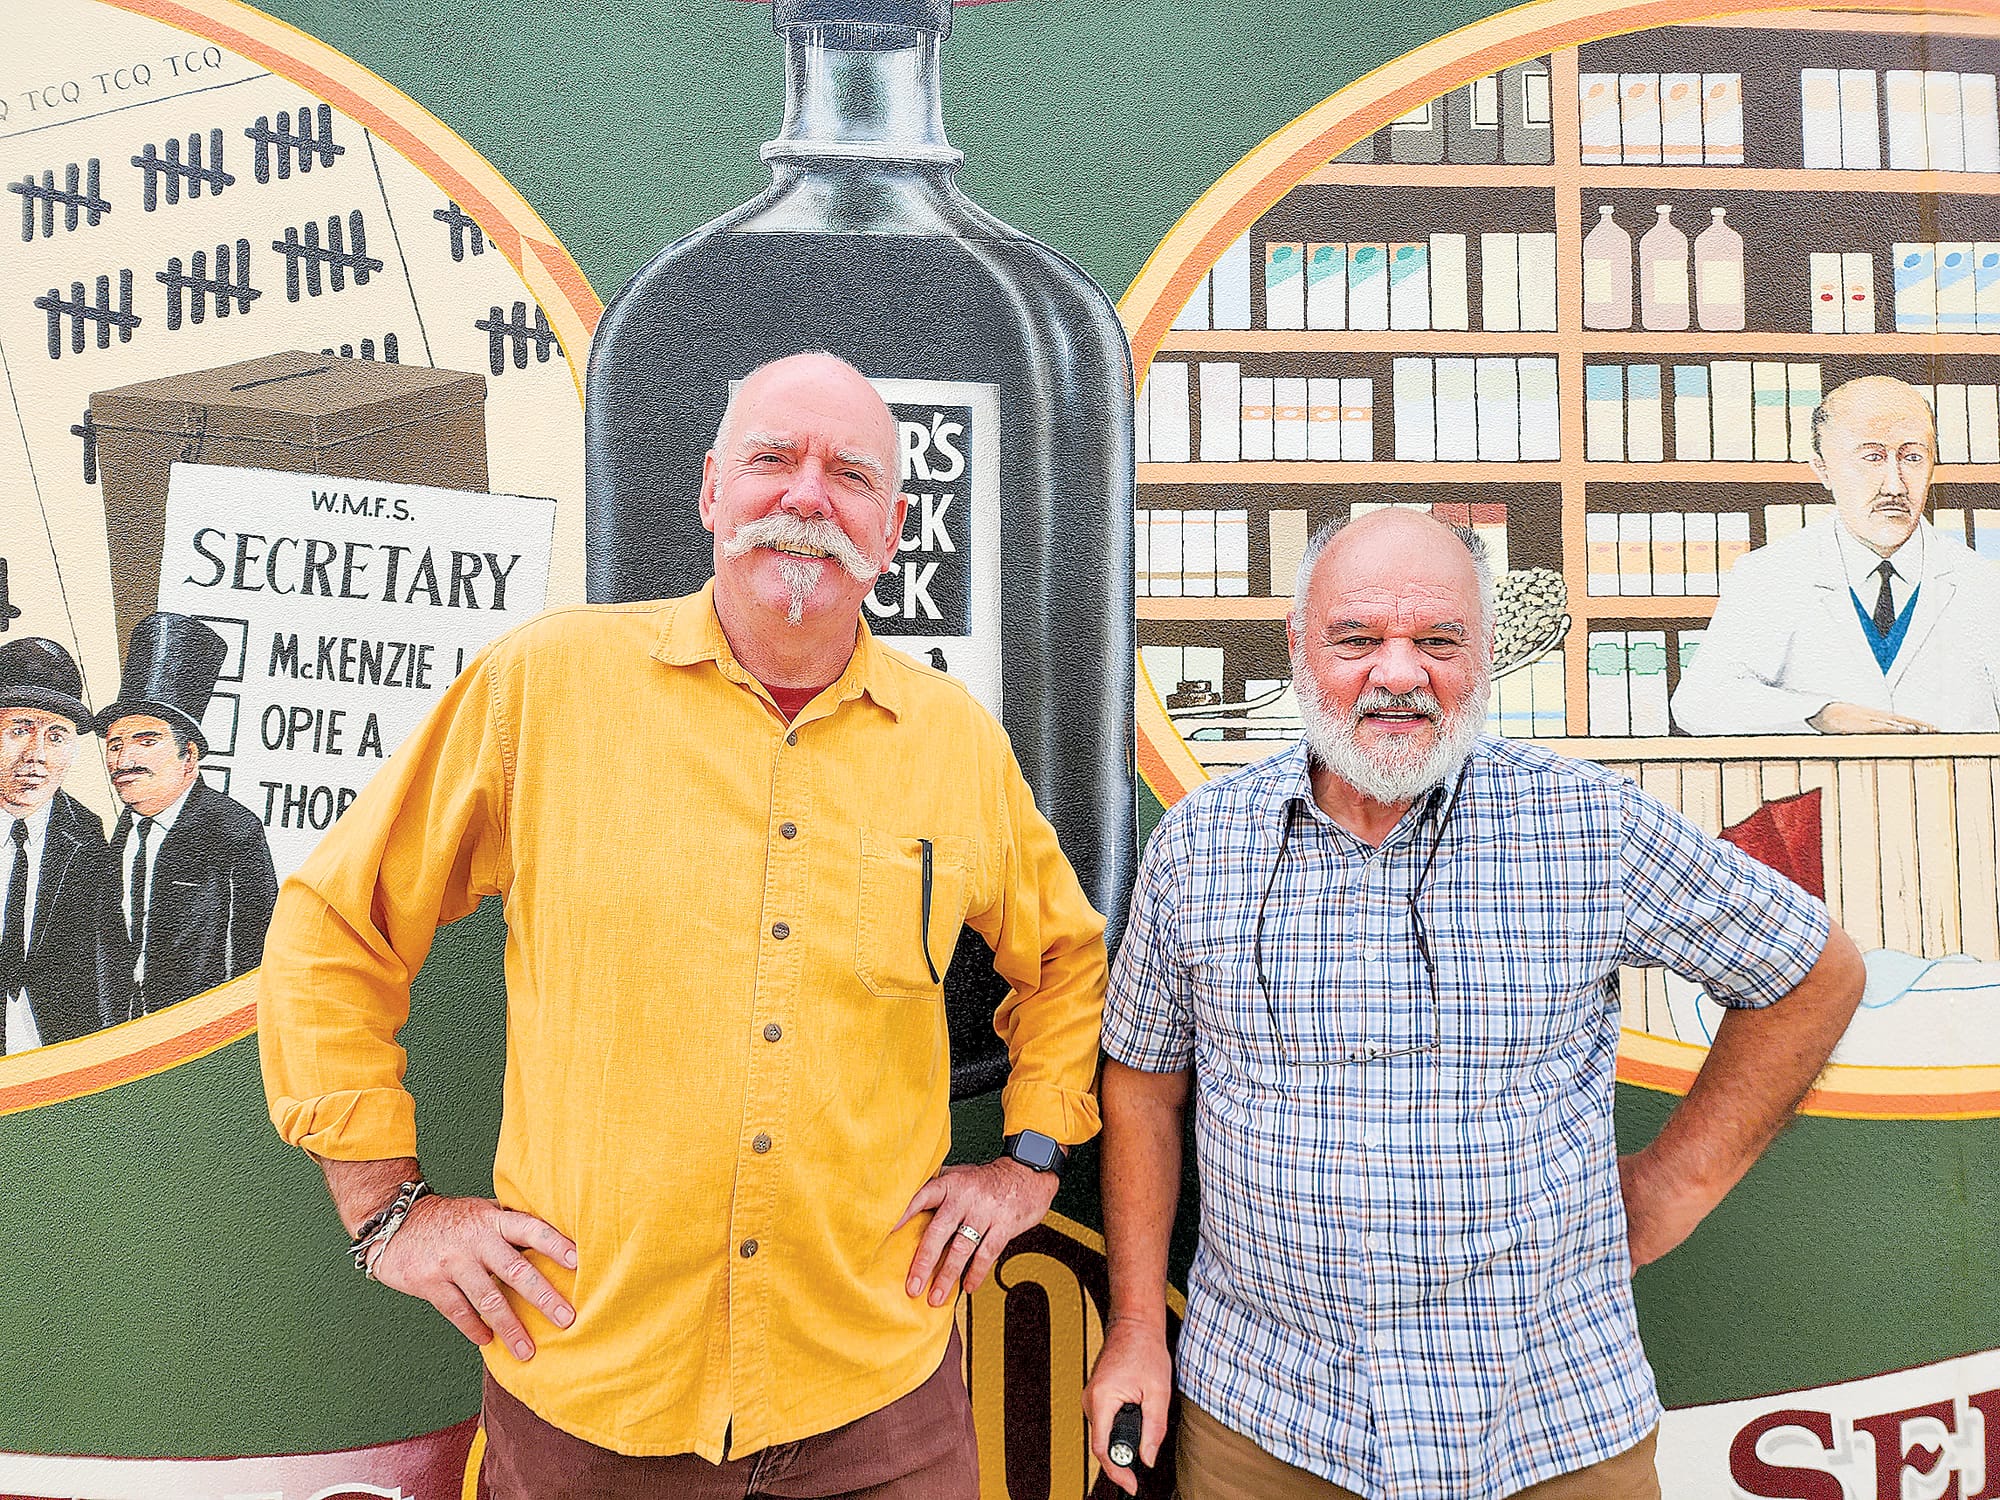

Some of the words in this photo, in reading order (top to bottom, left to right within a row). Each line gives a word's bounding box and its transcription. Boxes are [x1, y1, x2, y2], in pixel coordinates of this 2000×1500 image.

[20, 81, 80, 112] TCQ
[92, 64, 151, 94] TCQ
[163, 47, 221, 77] TCQ
[311, 490, 416, 522] W.M.F.S.
[183, 527, 522, 611] SECRETARY
[863, 561, 944, 620] CK
[268, 632, 435, 690] McKENZIE
[261, 704, 347, 755] OPIE
